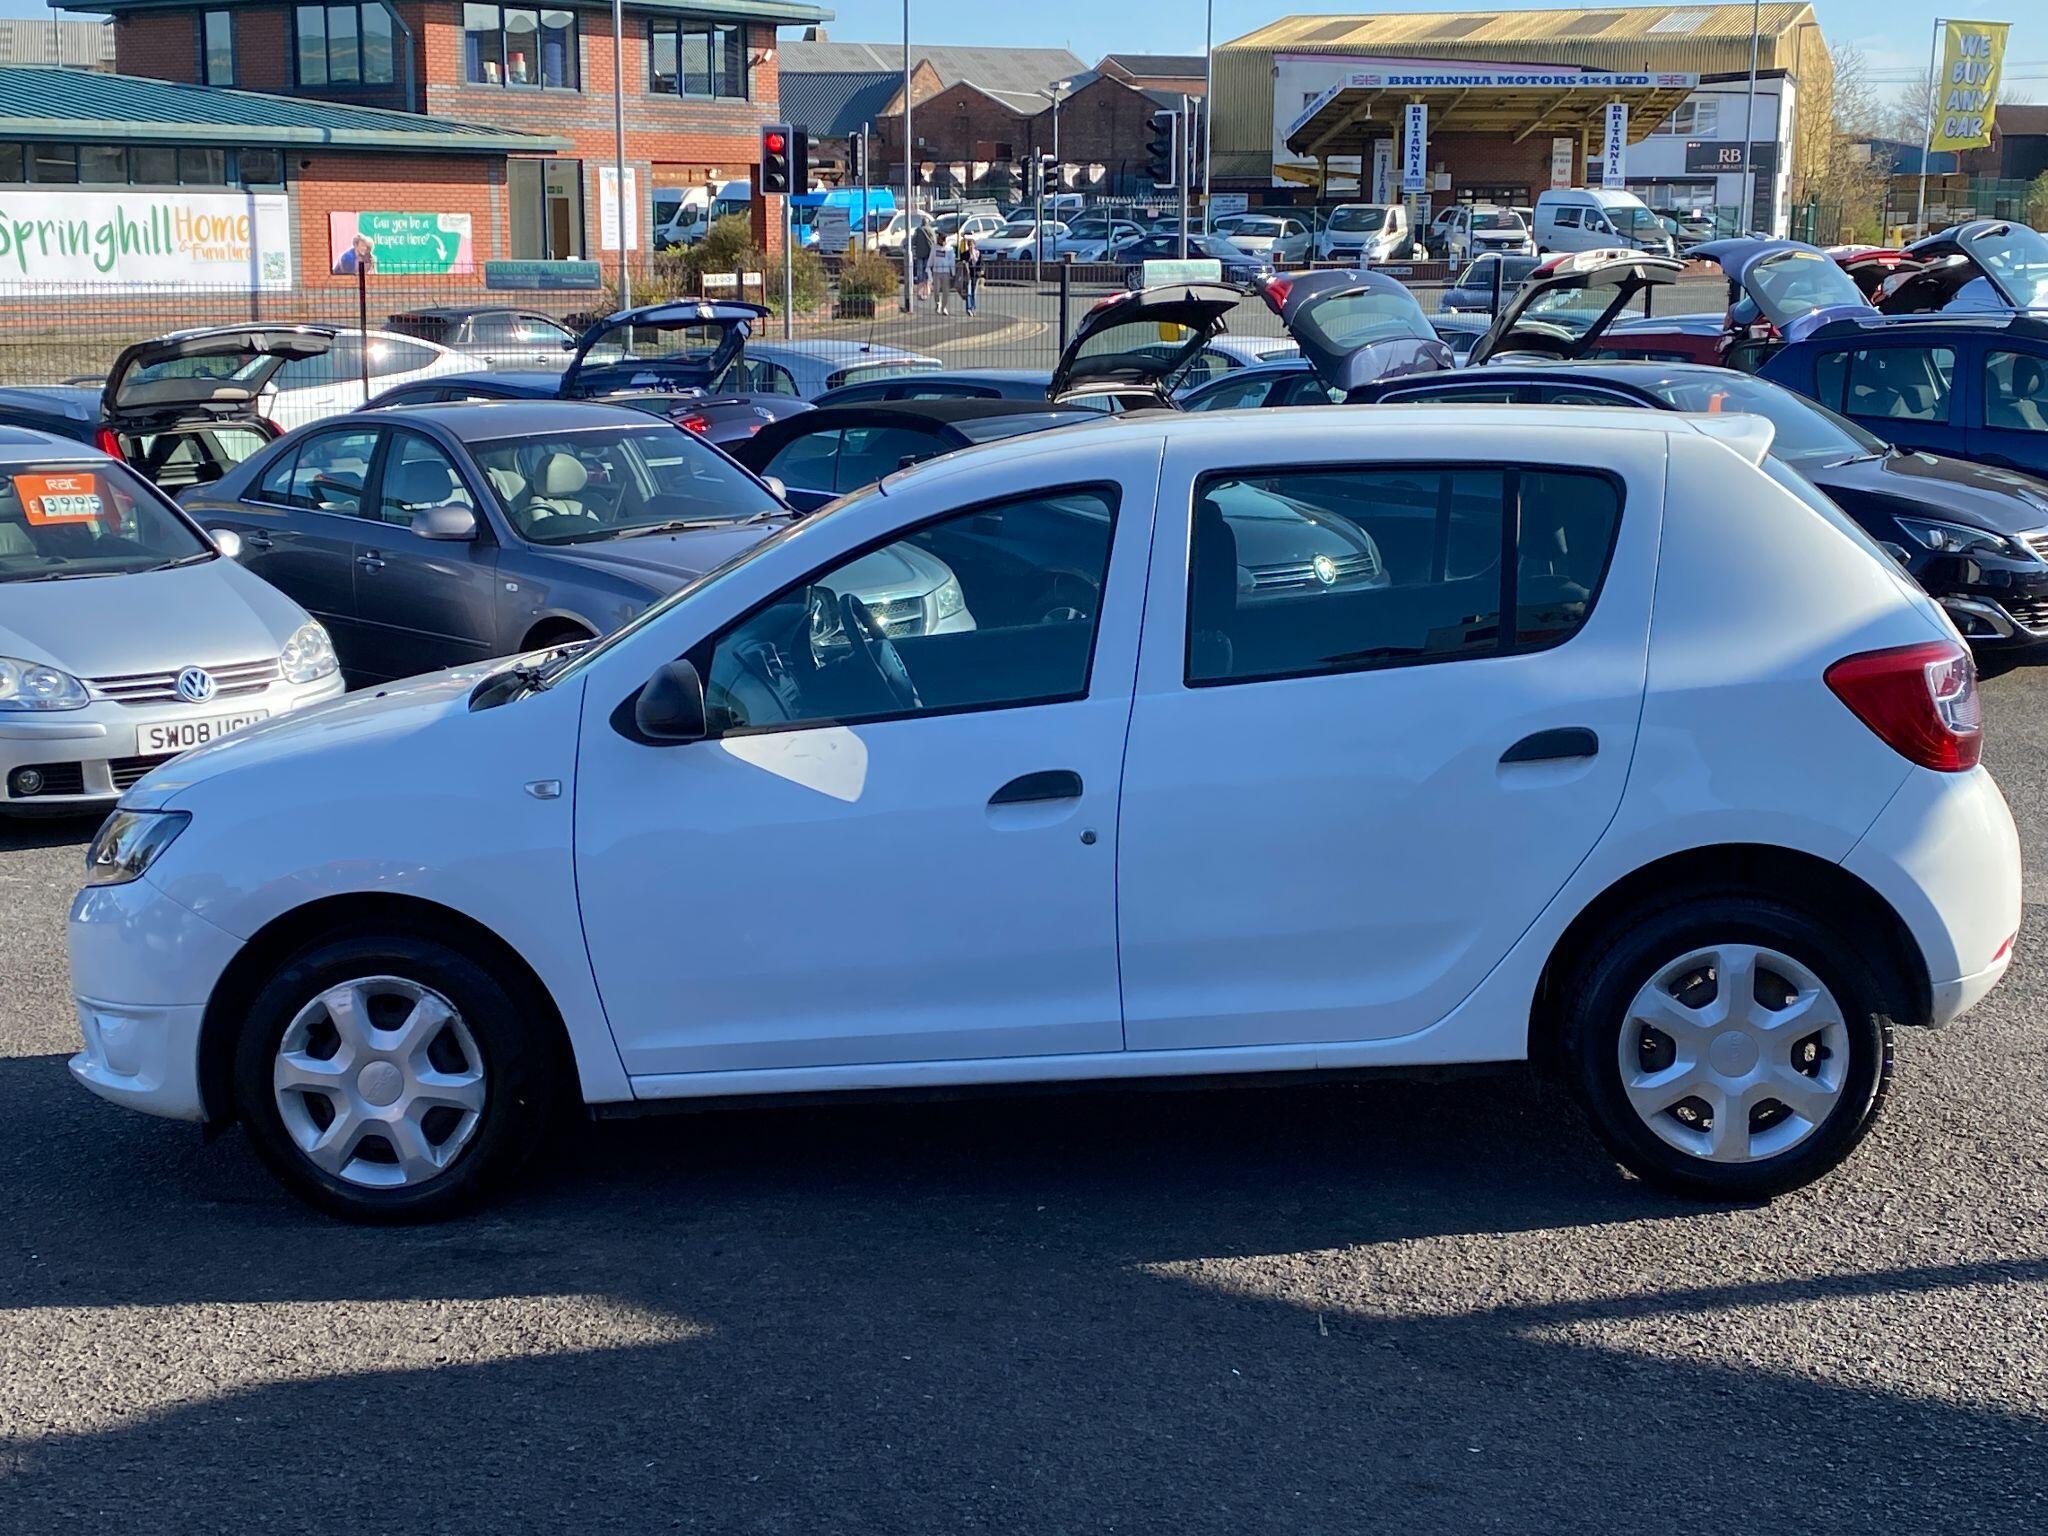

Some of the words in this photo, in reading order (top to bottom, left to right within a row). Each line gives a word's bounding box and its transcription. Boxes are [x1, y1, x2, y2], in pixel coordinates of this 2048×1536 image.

[1960, 35, 1992, 59] WE
[1387, 75, 1493, 86] BRITANNIA
[1497, 75, 1577, 86] MOTORS
[1615, 75, 1650, 86] LTD
[1952, 61, 1994, 85] BUY
[1945, 88, 1992, 113] ANY
[1944, 116, 1985, 139] CAR
[1410, 106, 1421, 177] BRITANNIA
[1609, 105, 1622, 175] BRITANNIA
[1718, 148, 1742, 163] RB
[175, 205, 250, 242] Home
[373, 216, 390, 229] Can
[391, 218, 408, 233] you
[422, 218, 430, 229] a
[487, 263, 537, 274] FINANCE
[541, 262, 599, 273] AVAILABLE
[150, 722, 210, 749] SW08
